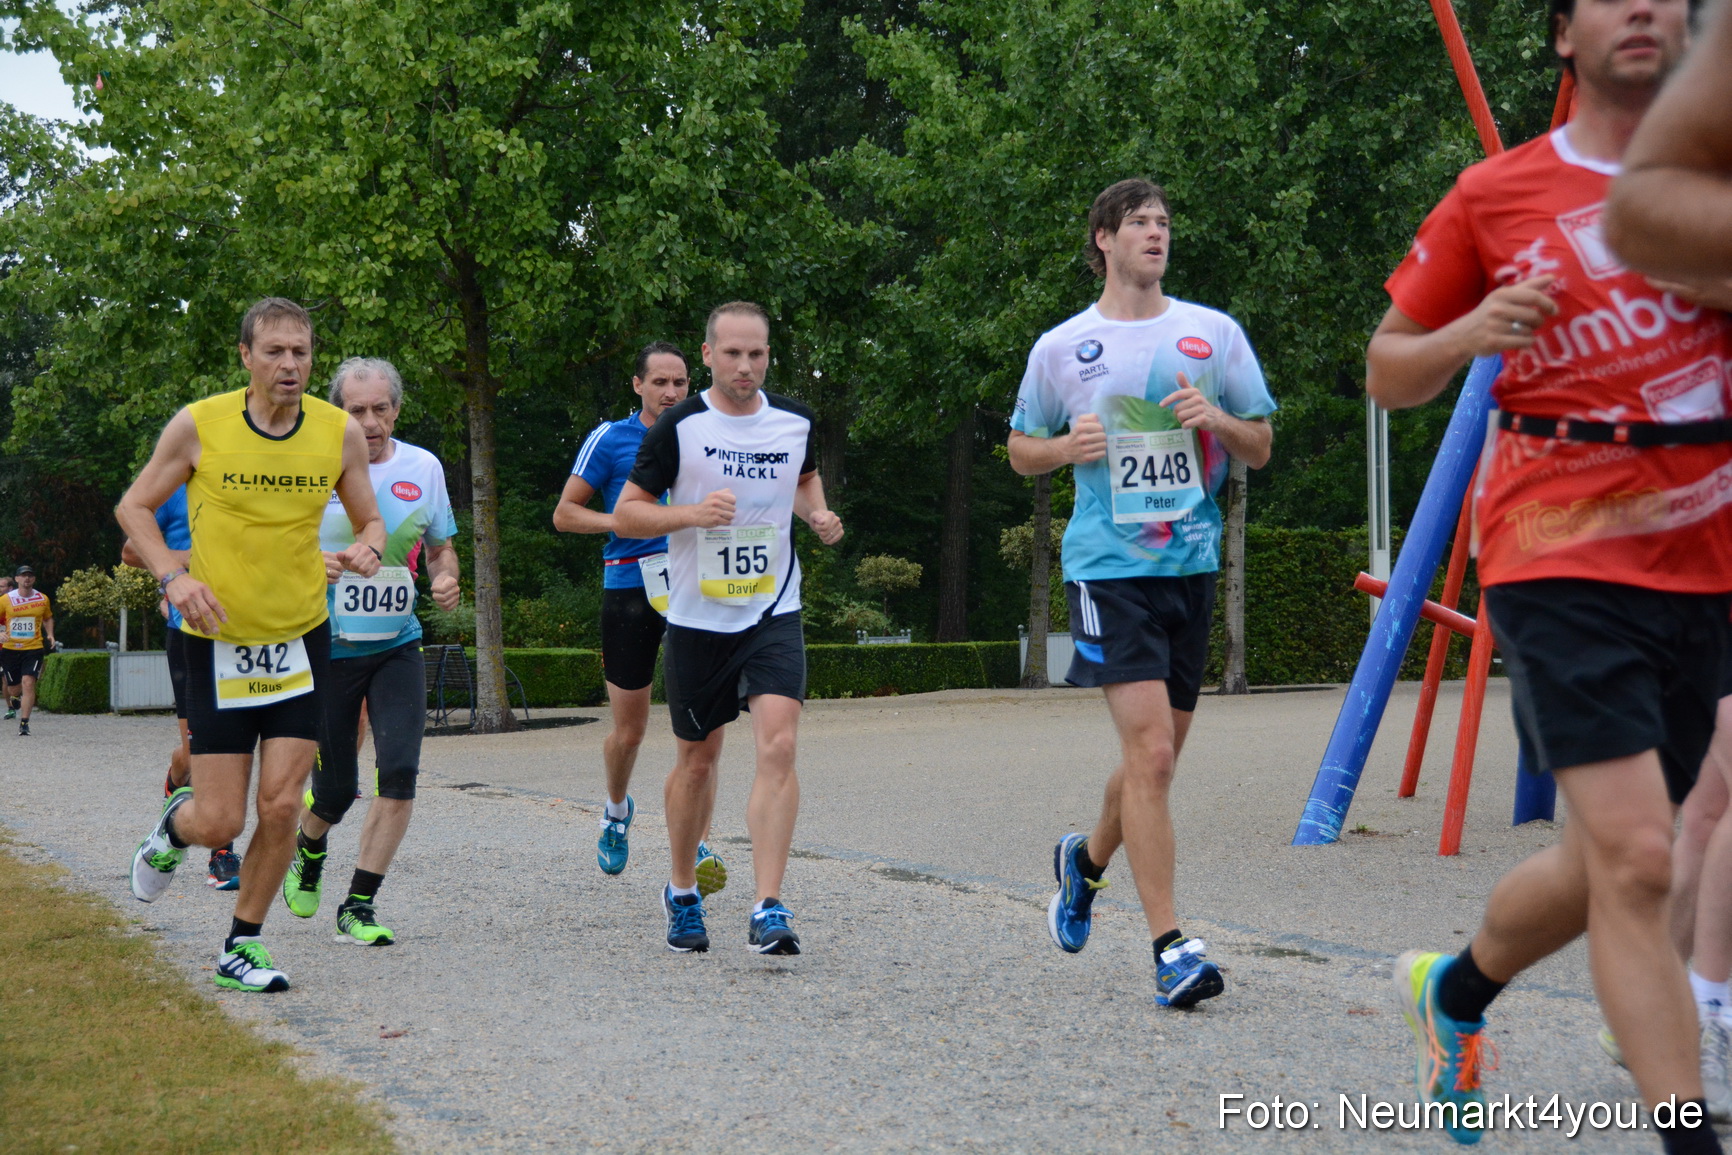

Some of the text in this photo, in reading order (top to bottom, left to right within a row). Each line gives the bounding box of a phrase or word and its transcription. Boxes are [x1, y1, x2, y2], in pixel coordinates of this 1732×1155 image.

[1181, 341, 1209, 354] Hervis
[1079, 364, 1108, 378] PARTL
[718, 449, 789, 464] INTERSPORT
[723, 464, 777, 479] HÄCKL
[1120, 452, 1191, 488] 2448
[222, 473, 328, 487] KLINGELE
[395, 485, 419, 497] Hervis
[1145, 496, 1176, 509] Peter
[717, 545, 768, 575] 155
[658, 567, 670, 591] 1
[343, 584, 409, 613] 3049
[12, 622, 33, 631] 2813
[235, 642, 291, 674] 342
[248, 682, 282, 694] Klaus
